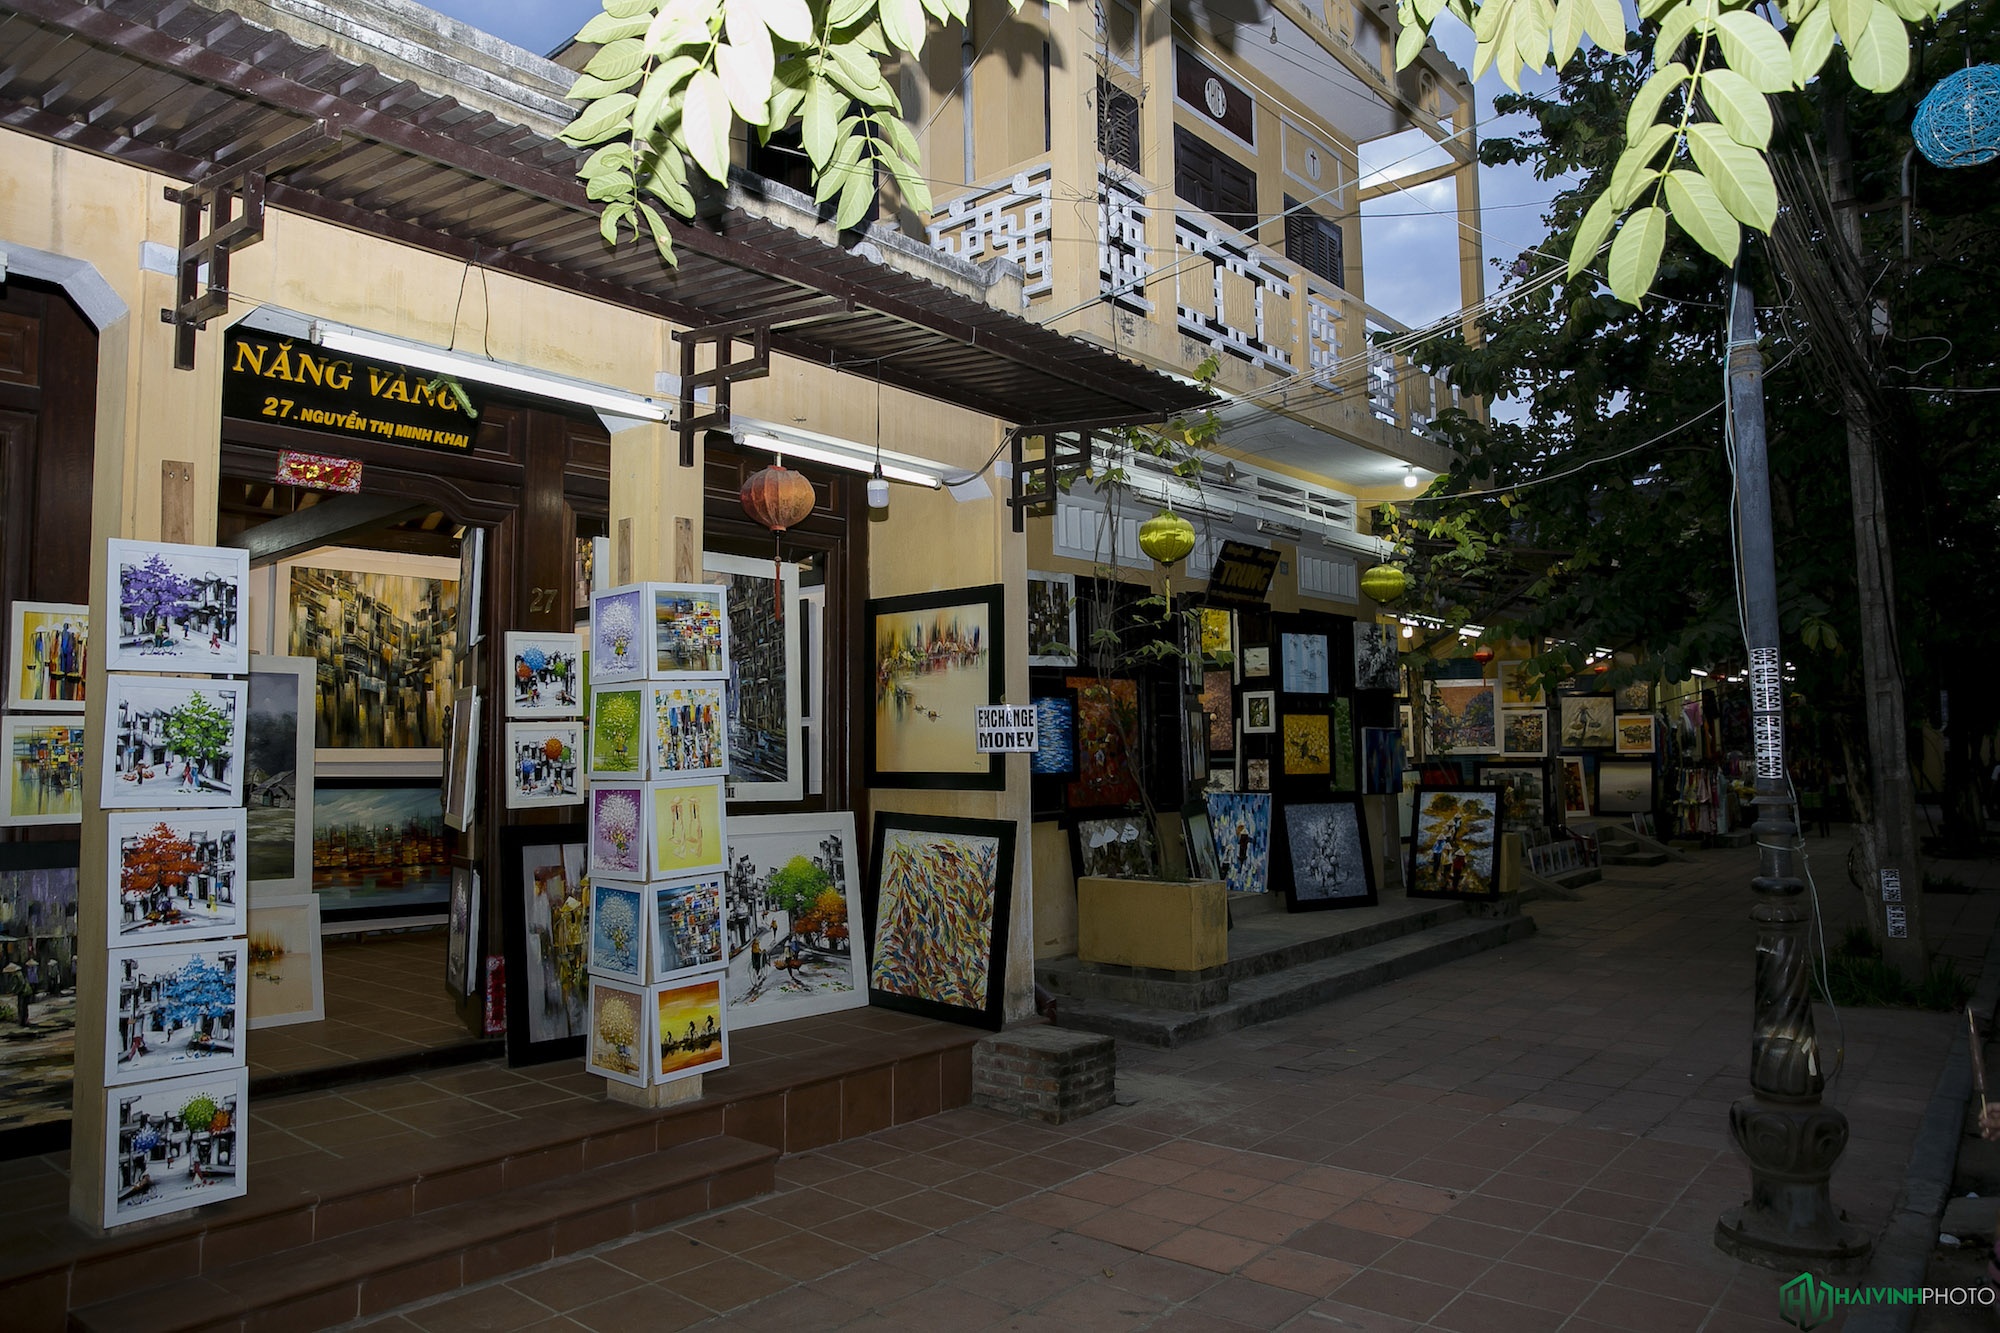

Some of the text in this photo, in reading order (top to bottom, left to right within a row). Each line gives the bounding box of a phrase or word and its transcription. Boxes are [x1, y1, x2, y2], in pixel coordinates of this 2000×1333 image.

[232, 338, 462, 411] NẮNG VÀNG
[301, 407, 367, 432] NGUYỄN
[370, 419, 395, 439] THỊ
[395, 424, 433, 442] MINH
[433, 430, 469, 448] KHAI
[530, 587, 558, 614] 27
[978, 709, 1034, 728] EXCHANGE
[979, 732, 1034, 748] MONEY
